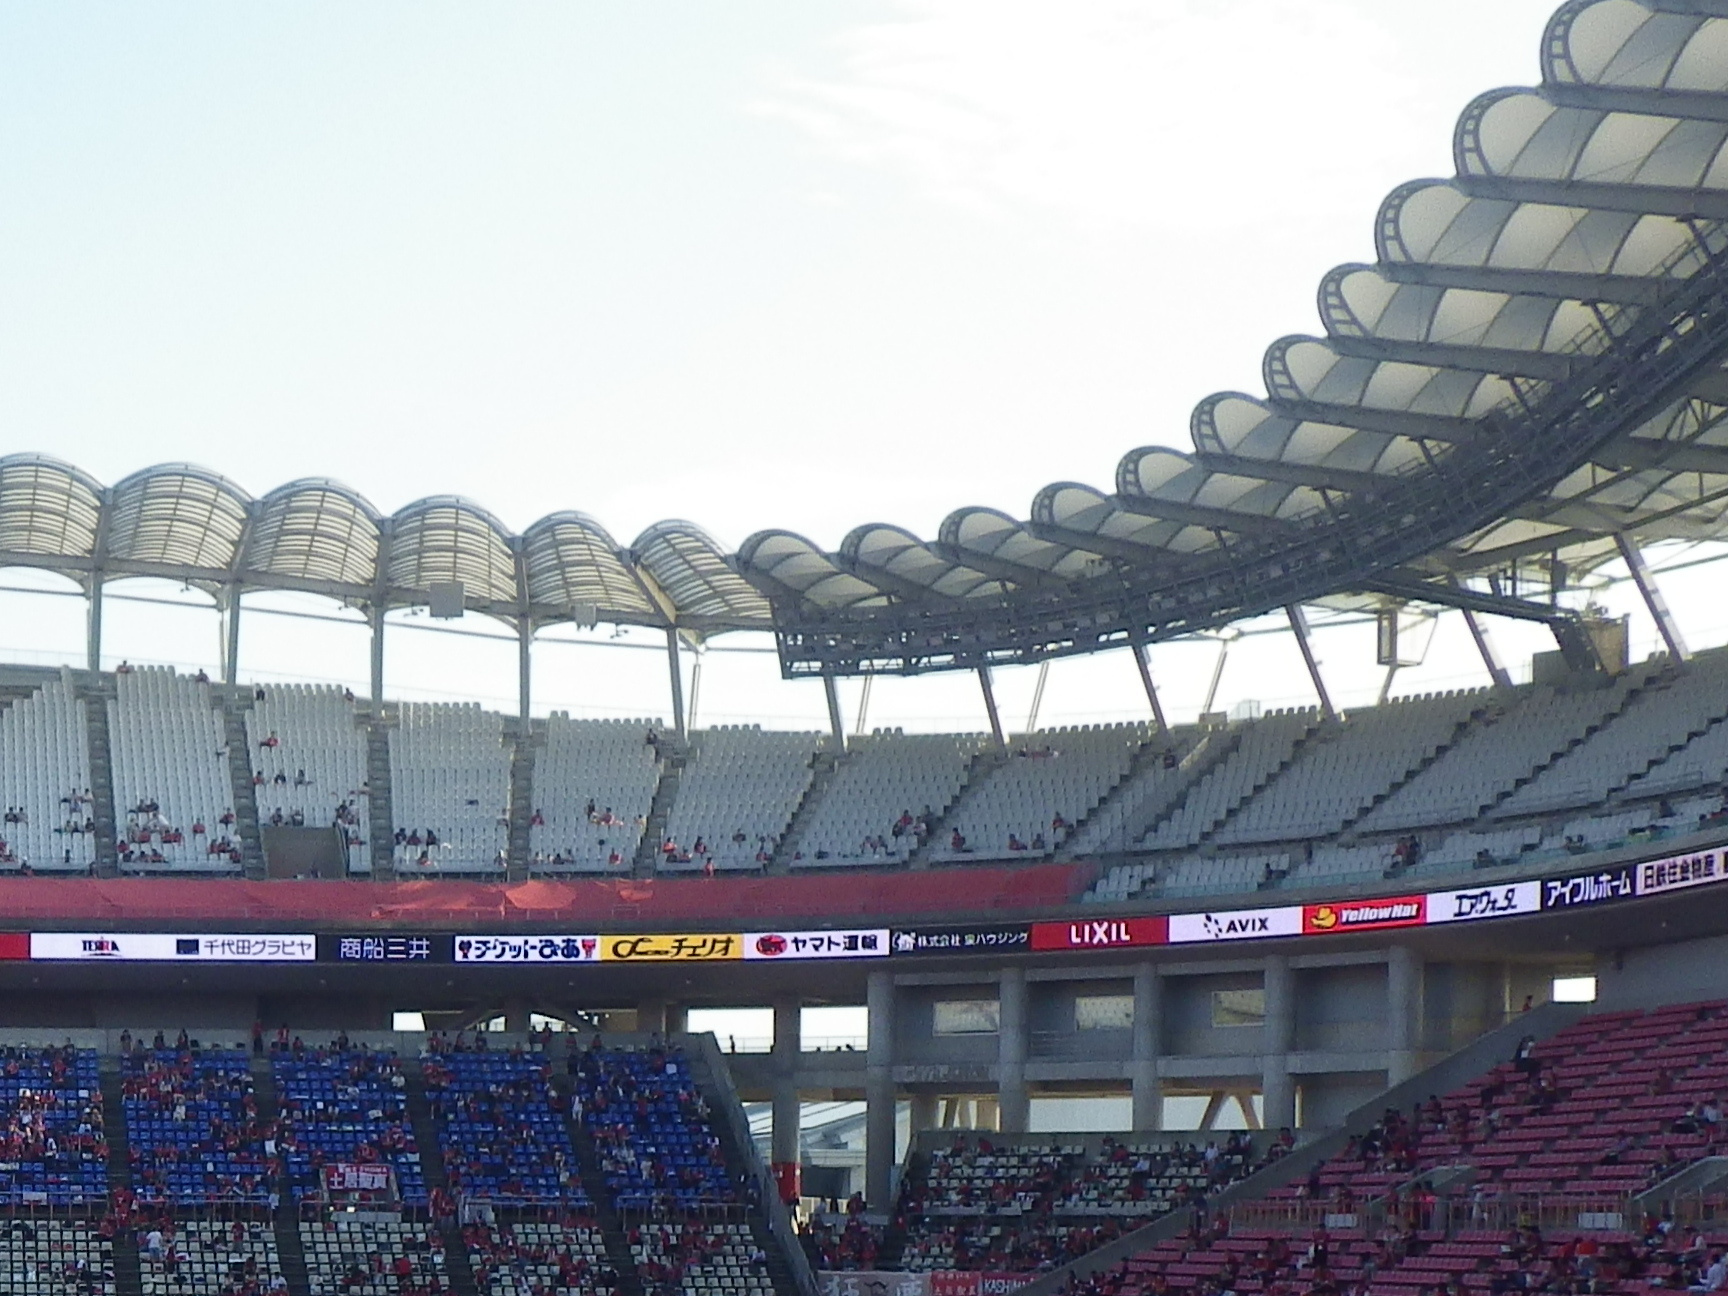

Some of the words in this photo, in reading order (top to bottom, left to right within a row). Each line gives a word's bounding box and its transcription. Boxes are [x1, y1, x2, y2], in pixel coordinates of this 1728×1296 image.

[1546, 870, 1632, 907] アイフルホーム
[1070, 921, 1130, 944] LIXIL
[1225, 917, 1270, 934] AVIX
[204, 939, 312, 956] 千代田グラビヤ
[340, 937, 430, 959] 商船三井
[474, 938, 580, 959] チケットぴあ
[790, 934, 878, 952] ヤマト運輸
